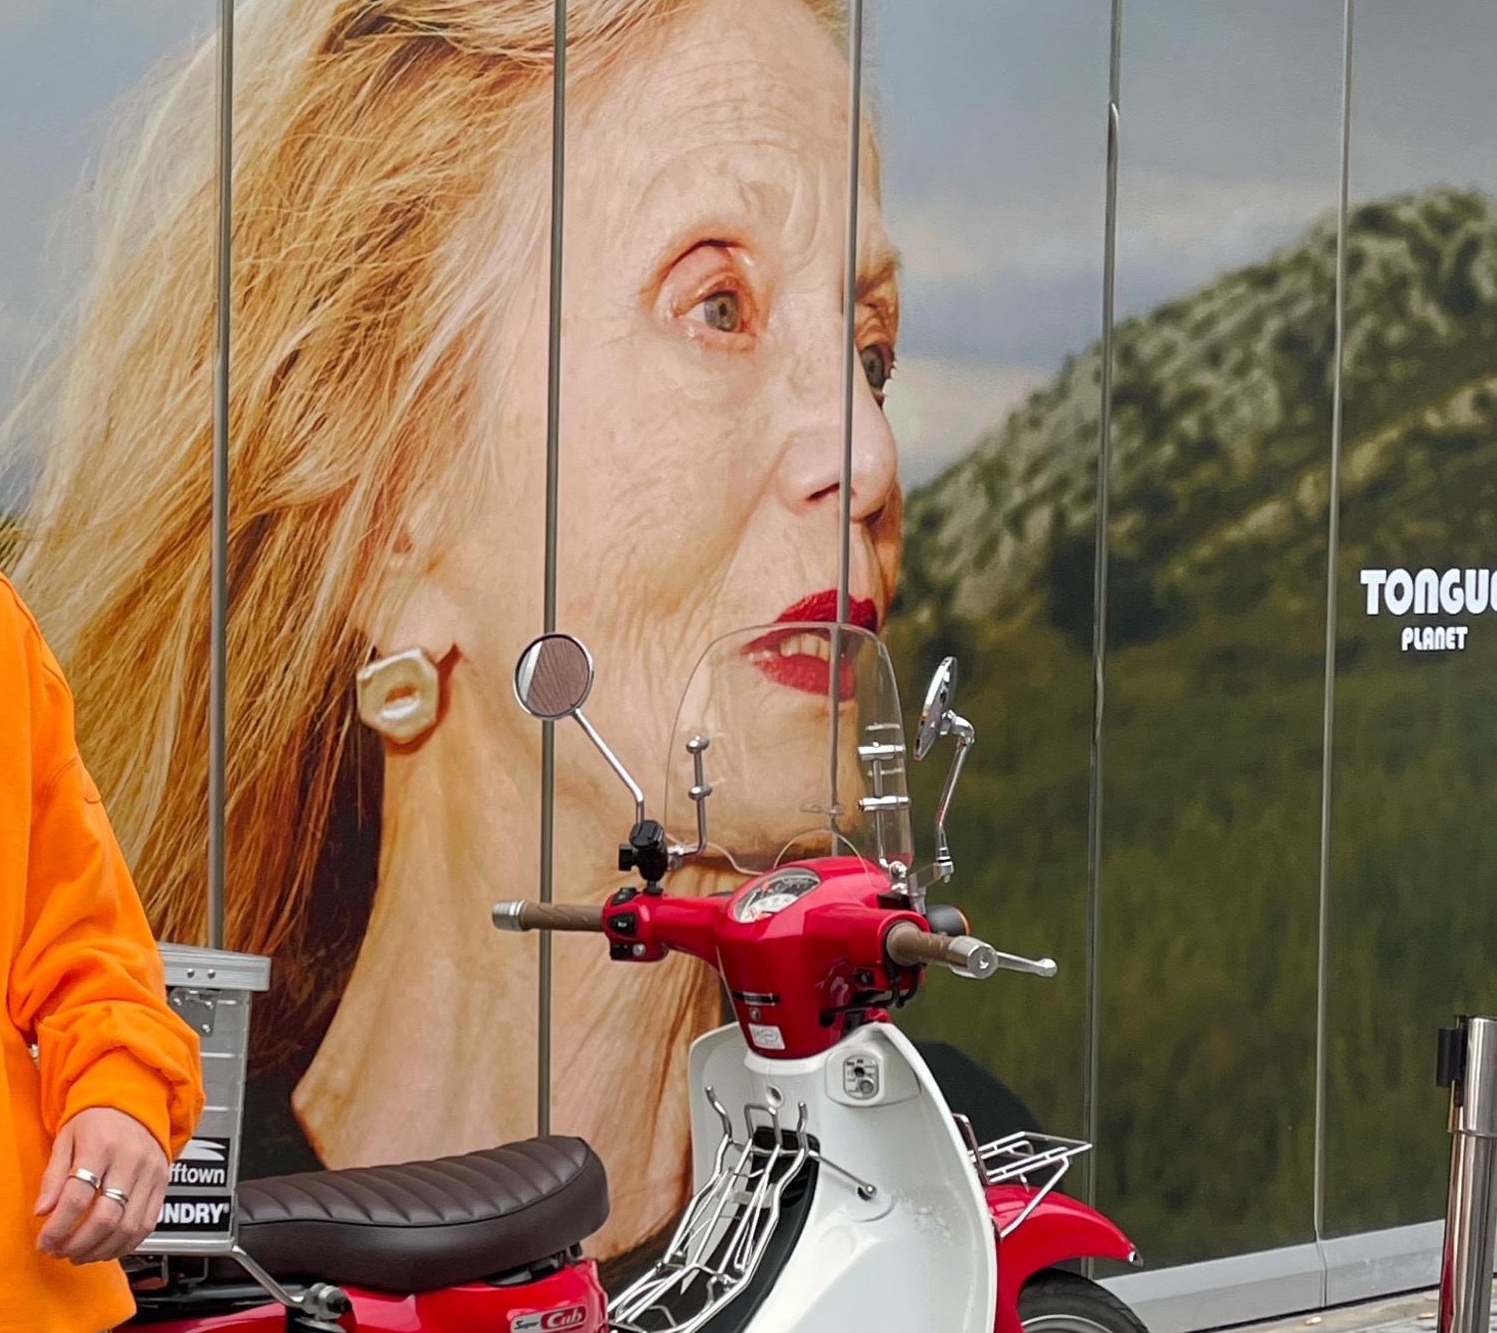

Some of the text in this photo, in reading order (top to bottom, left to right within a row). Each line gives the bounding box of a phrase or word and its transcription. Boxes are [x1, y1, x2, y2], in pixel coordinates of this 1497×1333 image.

[1360, 568, 1497, 615] TONGU
[1401, 626, 1468, 651] PLANET
[168, 1162, 225, 1184] fftown
[547, 1307, 583, 1328] Cub
